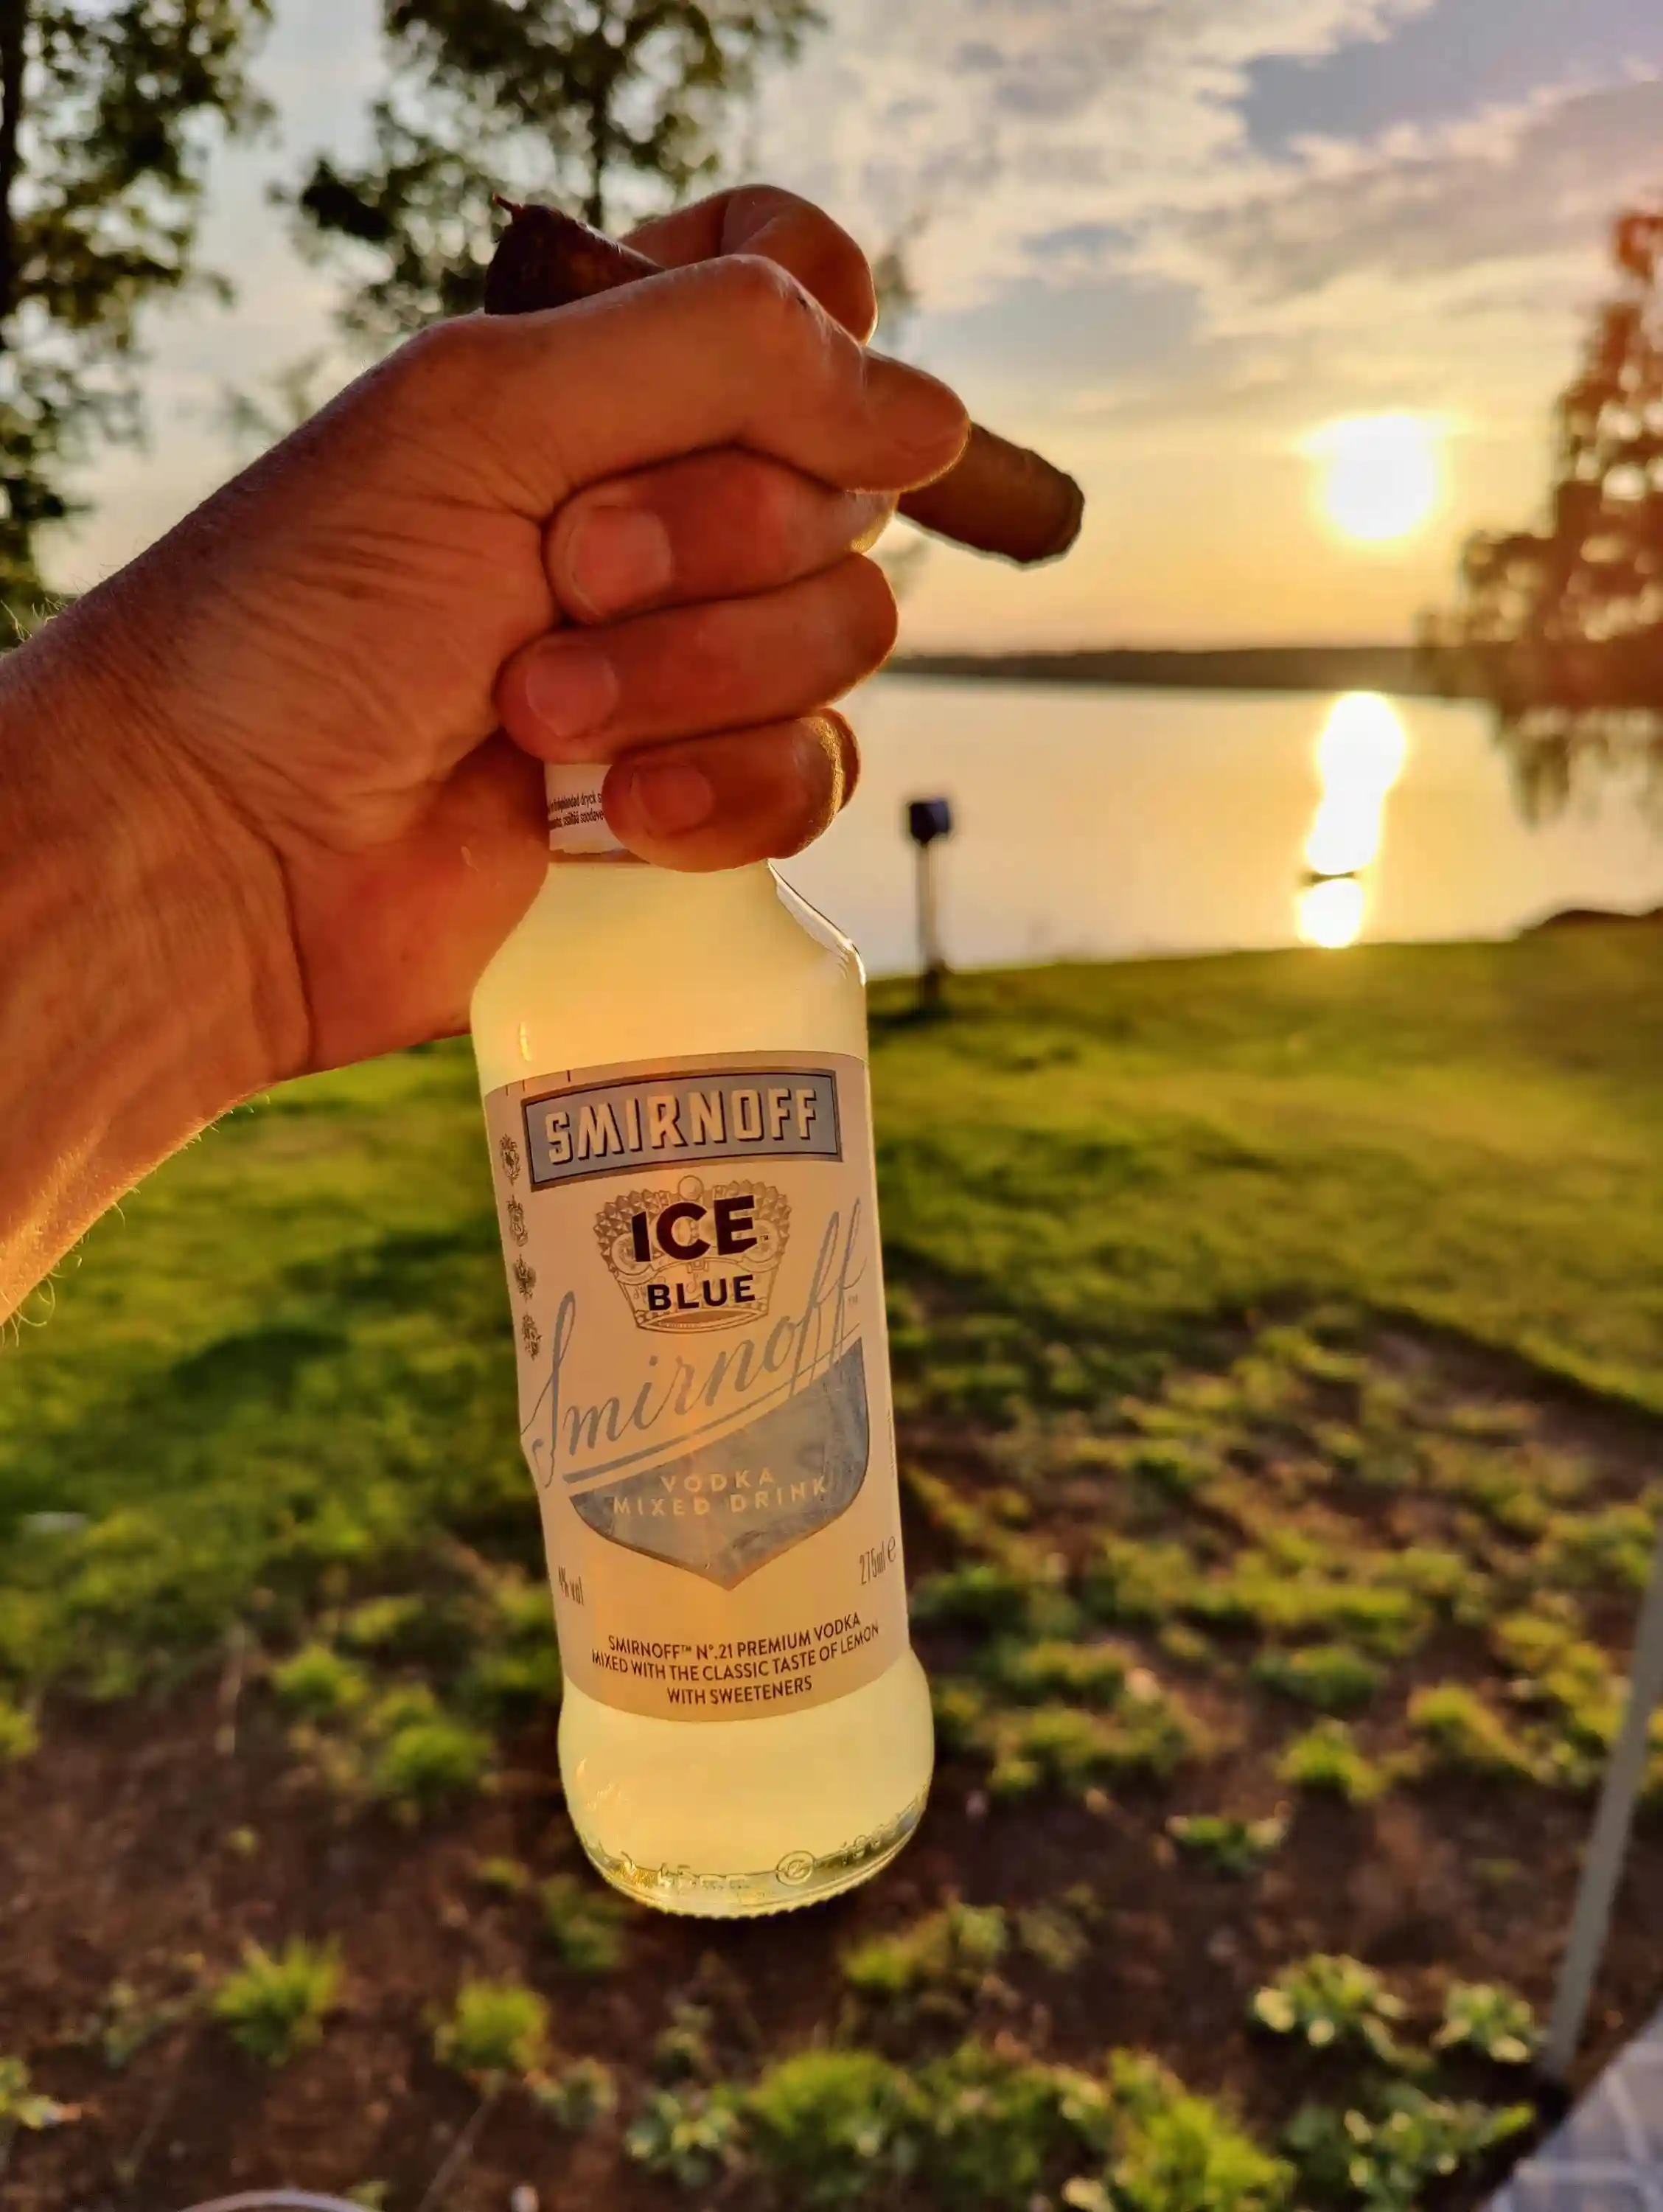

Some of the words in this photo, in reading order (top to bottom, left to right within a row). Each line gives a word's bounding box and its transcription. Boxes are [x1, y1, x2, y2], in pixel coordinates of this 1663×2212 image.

[545, 1088, 816, 1165] SMIRNOFF
[632, 1195, 757, 1262] ICE
[647, 1274, 755, 1311] BLUE
[520, 1196, 867, 1489] Smirnoff
[613, 1496, 711, 1516] MIXED
[730, 1475, 827, 1513] DRINK
[660, 1467, 773, 1492] VODKA
[592, 1649, 627, 1673] MIXED
[631, 1660, 666, 1680] WITH
[669, 1665, 699, 1681] THE
[702, 1660, 769, 1681] CLASSIC
[772, 1649, 816, 1674] TASTE
[819, 1641, 837, 1661] OF
[841, 1618, 879, 1654] LEMON
[737, 1630, 811, 1658] PREMIUM
[814, 1612, 861, 1641] VODKA
[667, 1687, 705, 1705] WITH
[710, 1675, 812, 1705] SWEETENERS
